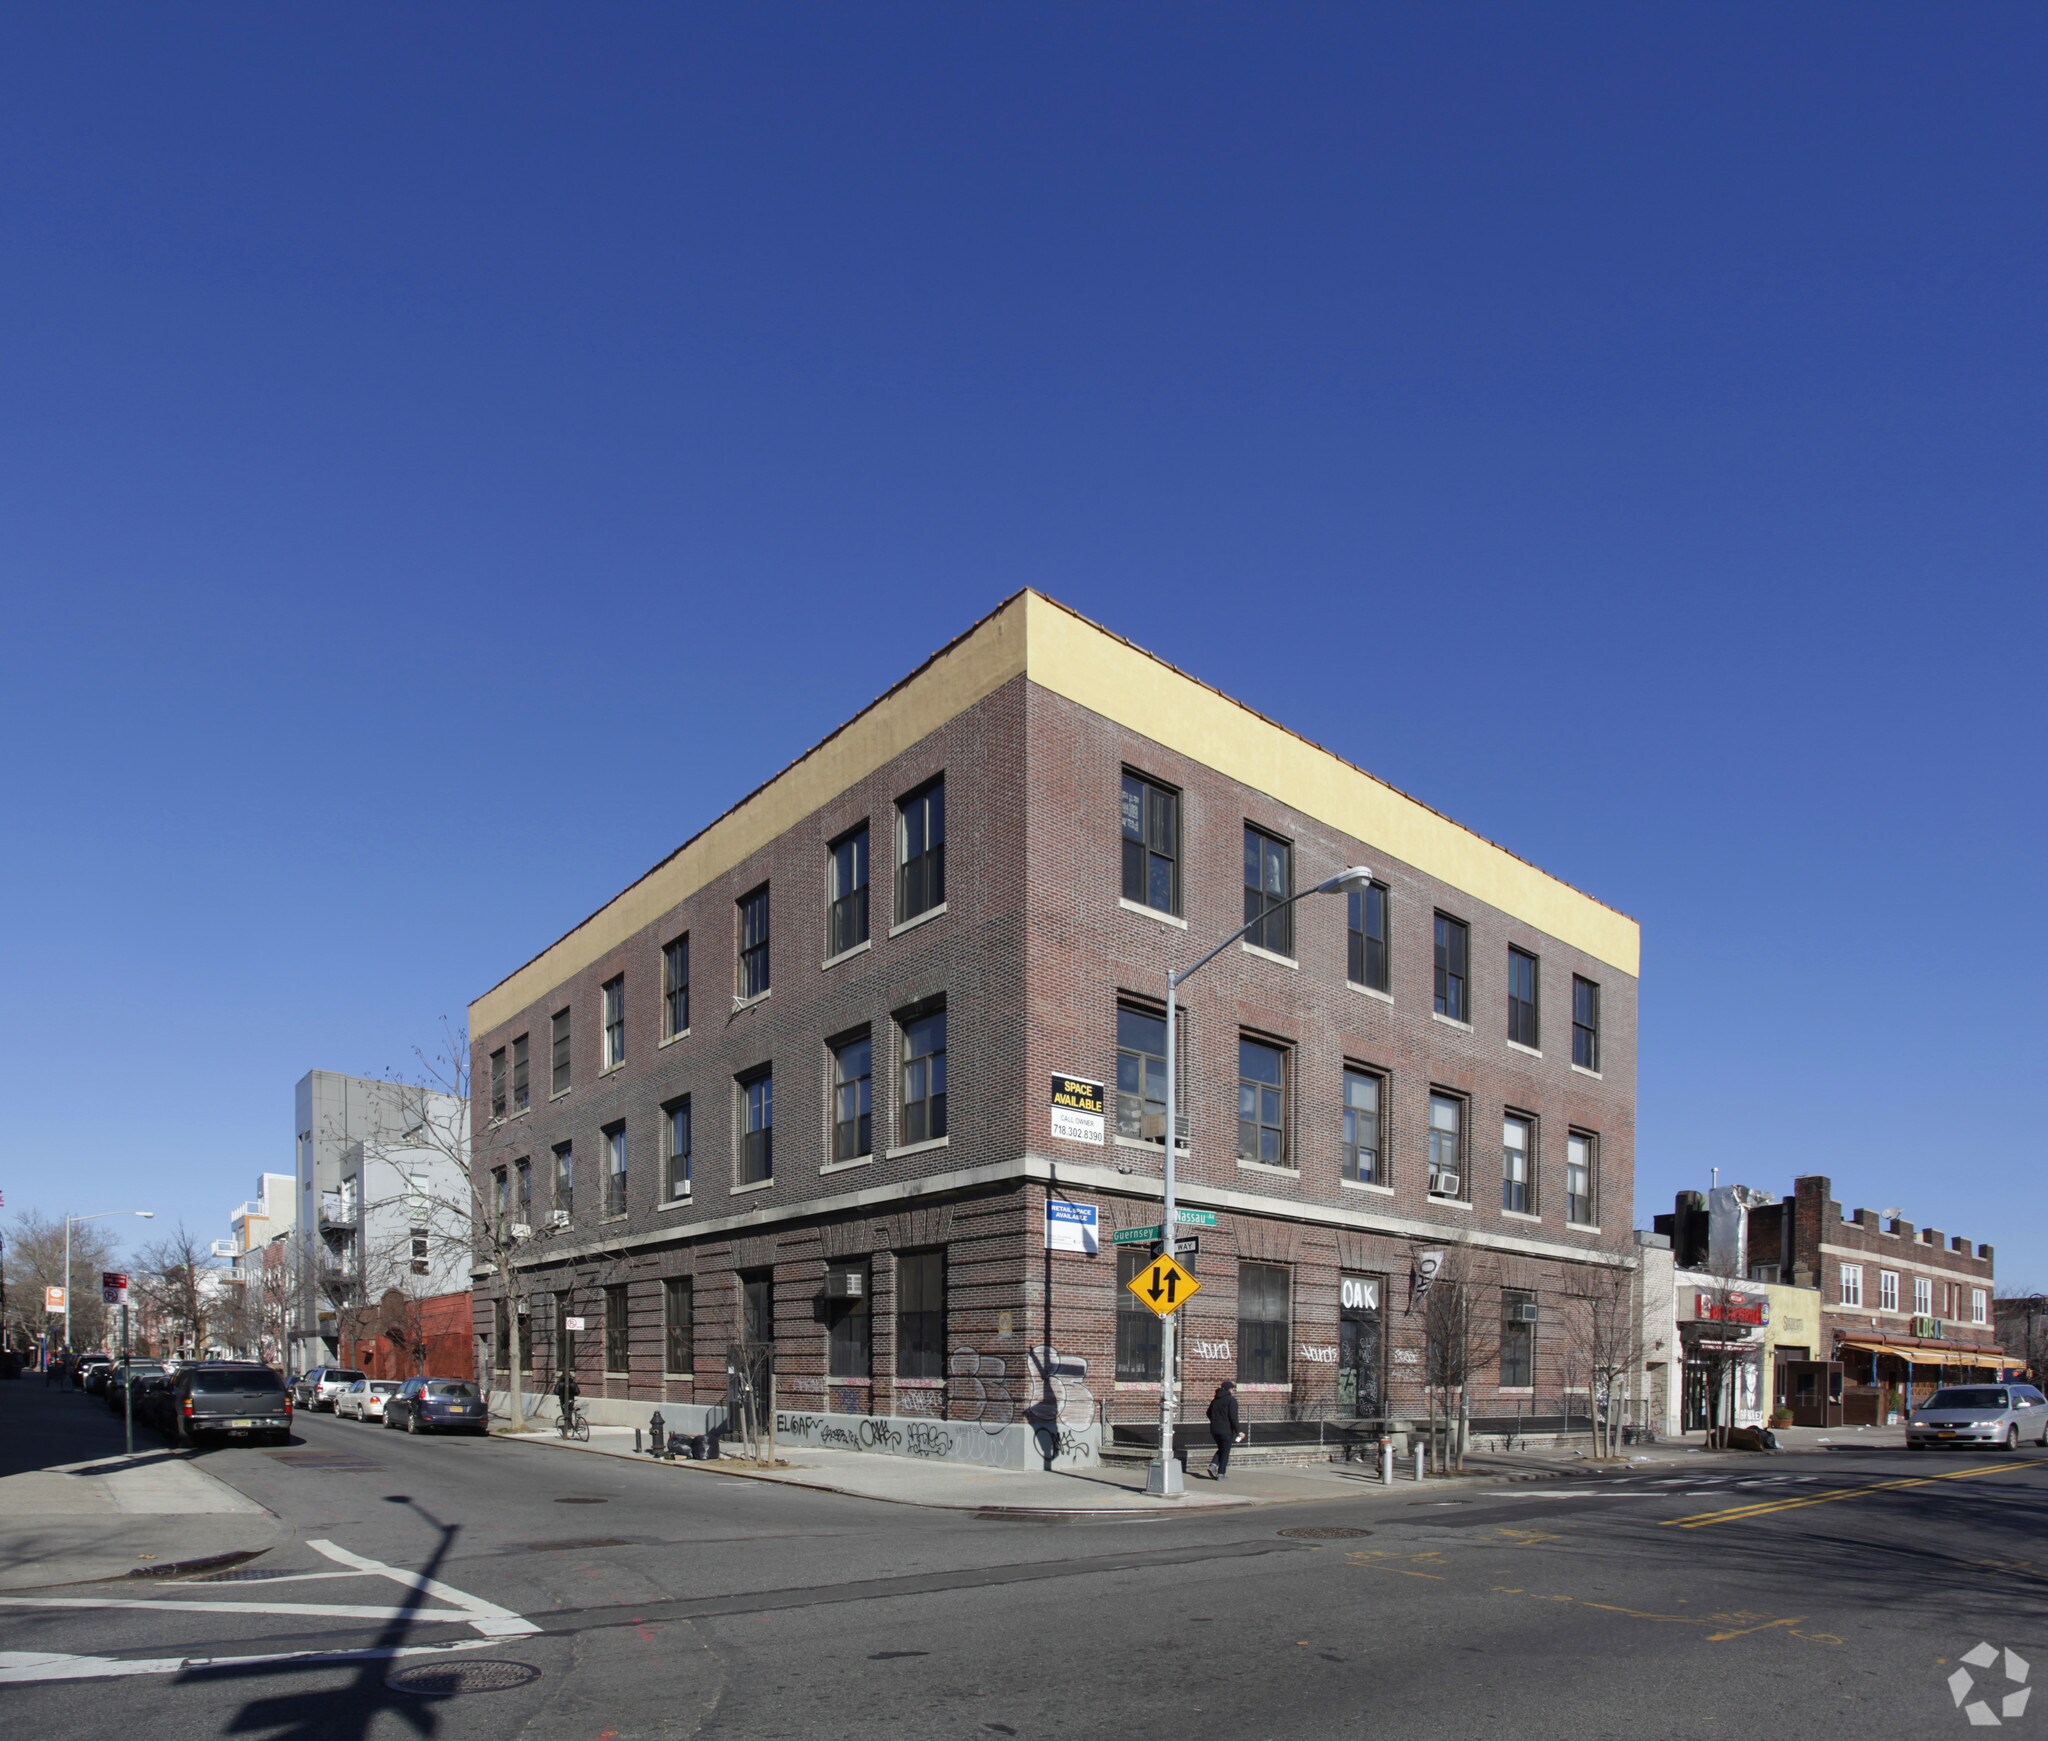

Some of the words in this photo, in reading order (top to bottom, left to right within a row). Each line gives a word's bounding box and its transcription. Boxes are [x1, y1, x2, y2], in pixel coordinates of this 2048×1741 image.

[1064, 1081, 1093, 1097] SPACE
[1054, 1093, 1103, 1112] AVAILABLE
[1060, 1115, 1074, 1124] CALL
[1075, 1118, 1095, 1127] OWNER
[1053, 1123, 1103, 1142] 718.302.8390
[1052, 1205, 1072, 1213] RETAIL
[1056, 1212, 1088, 1222] AVAILABLE
[1175, 1210, 1206, 1224] Nassau
[1113, 1228, 1154, 1241] Guernsey
[1177, 1242, 1193, 1251] WAY
[1342, 1280, 1376, 1311] OAK
